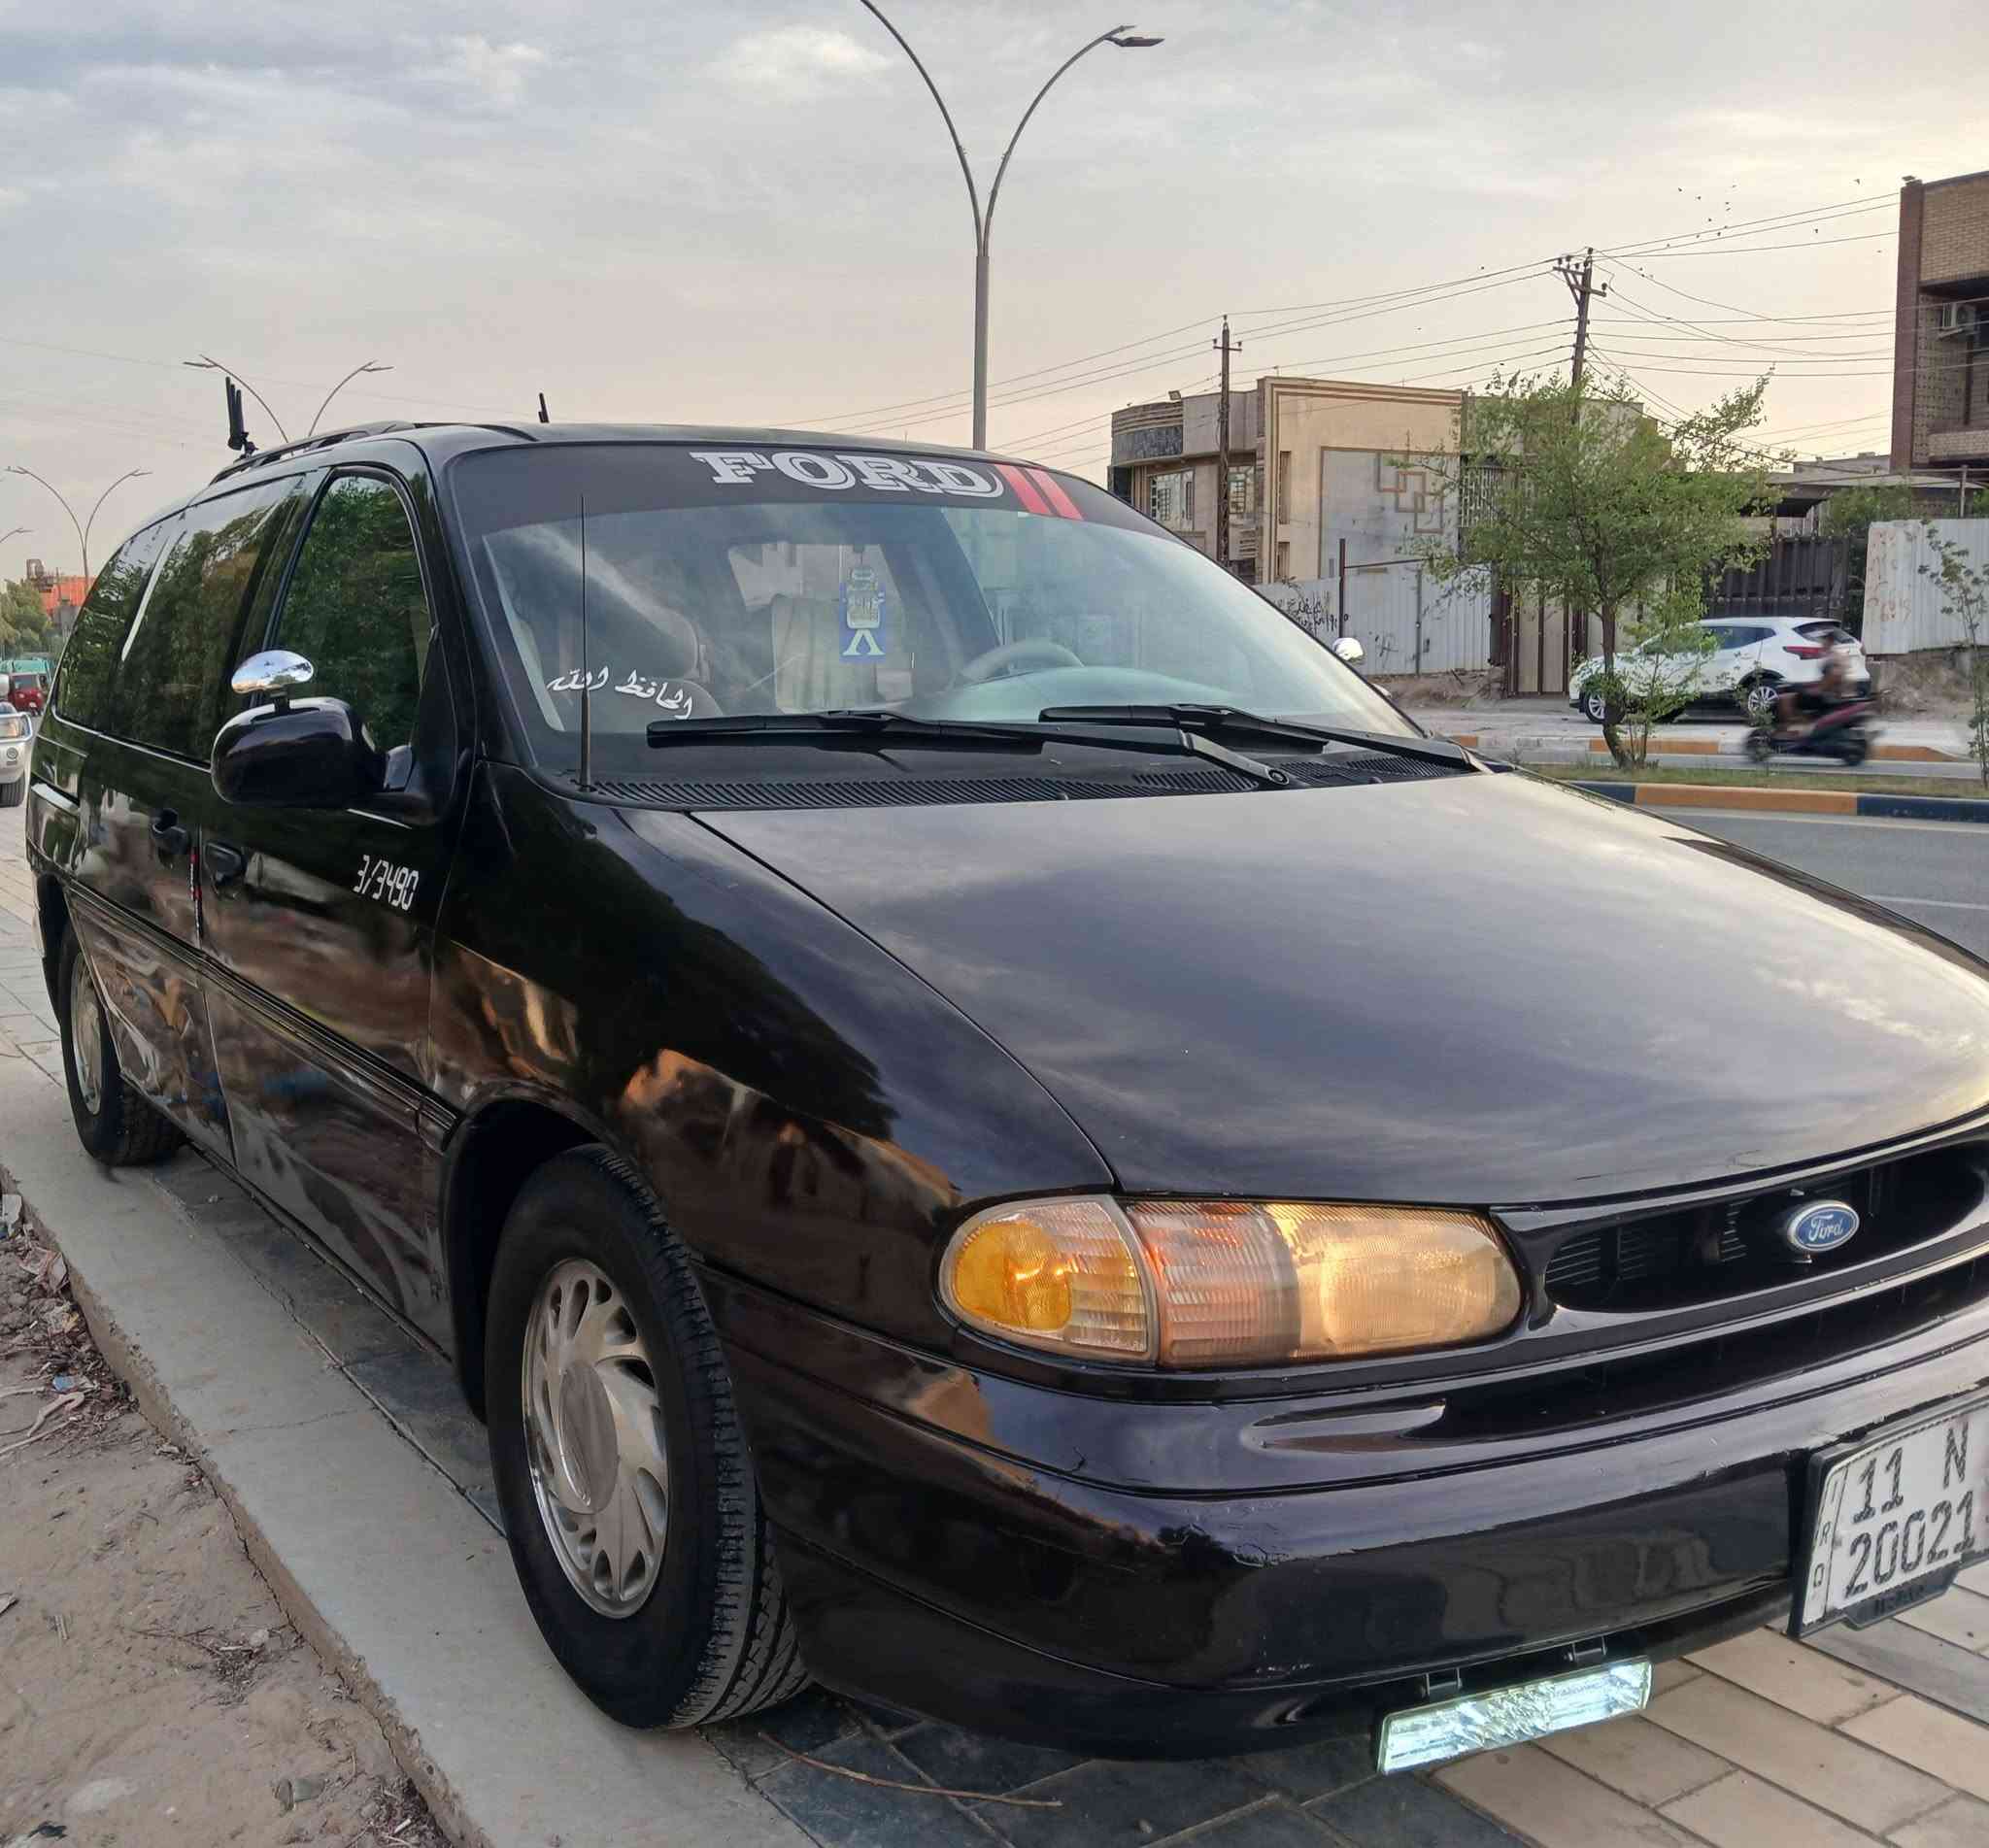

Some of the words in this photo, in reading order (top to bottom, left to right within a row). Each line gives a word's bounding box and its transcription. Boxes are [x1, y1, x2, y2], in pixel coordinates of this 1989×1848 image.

[690, 451, 1005, 499] FORD
[353, 855, 419, 911] 3/3490
[1808, 1214, 1844, 1241] Ford
[1852, 1447, 1905, 1525] 11
[1943, 1421, 1969, 1489] N
[1845, 1490, 1975, 1598] 20021
